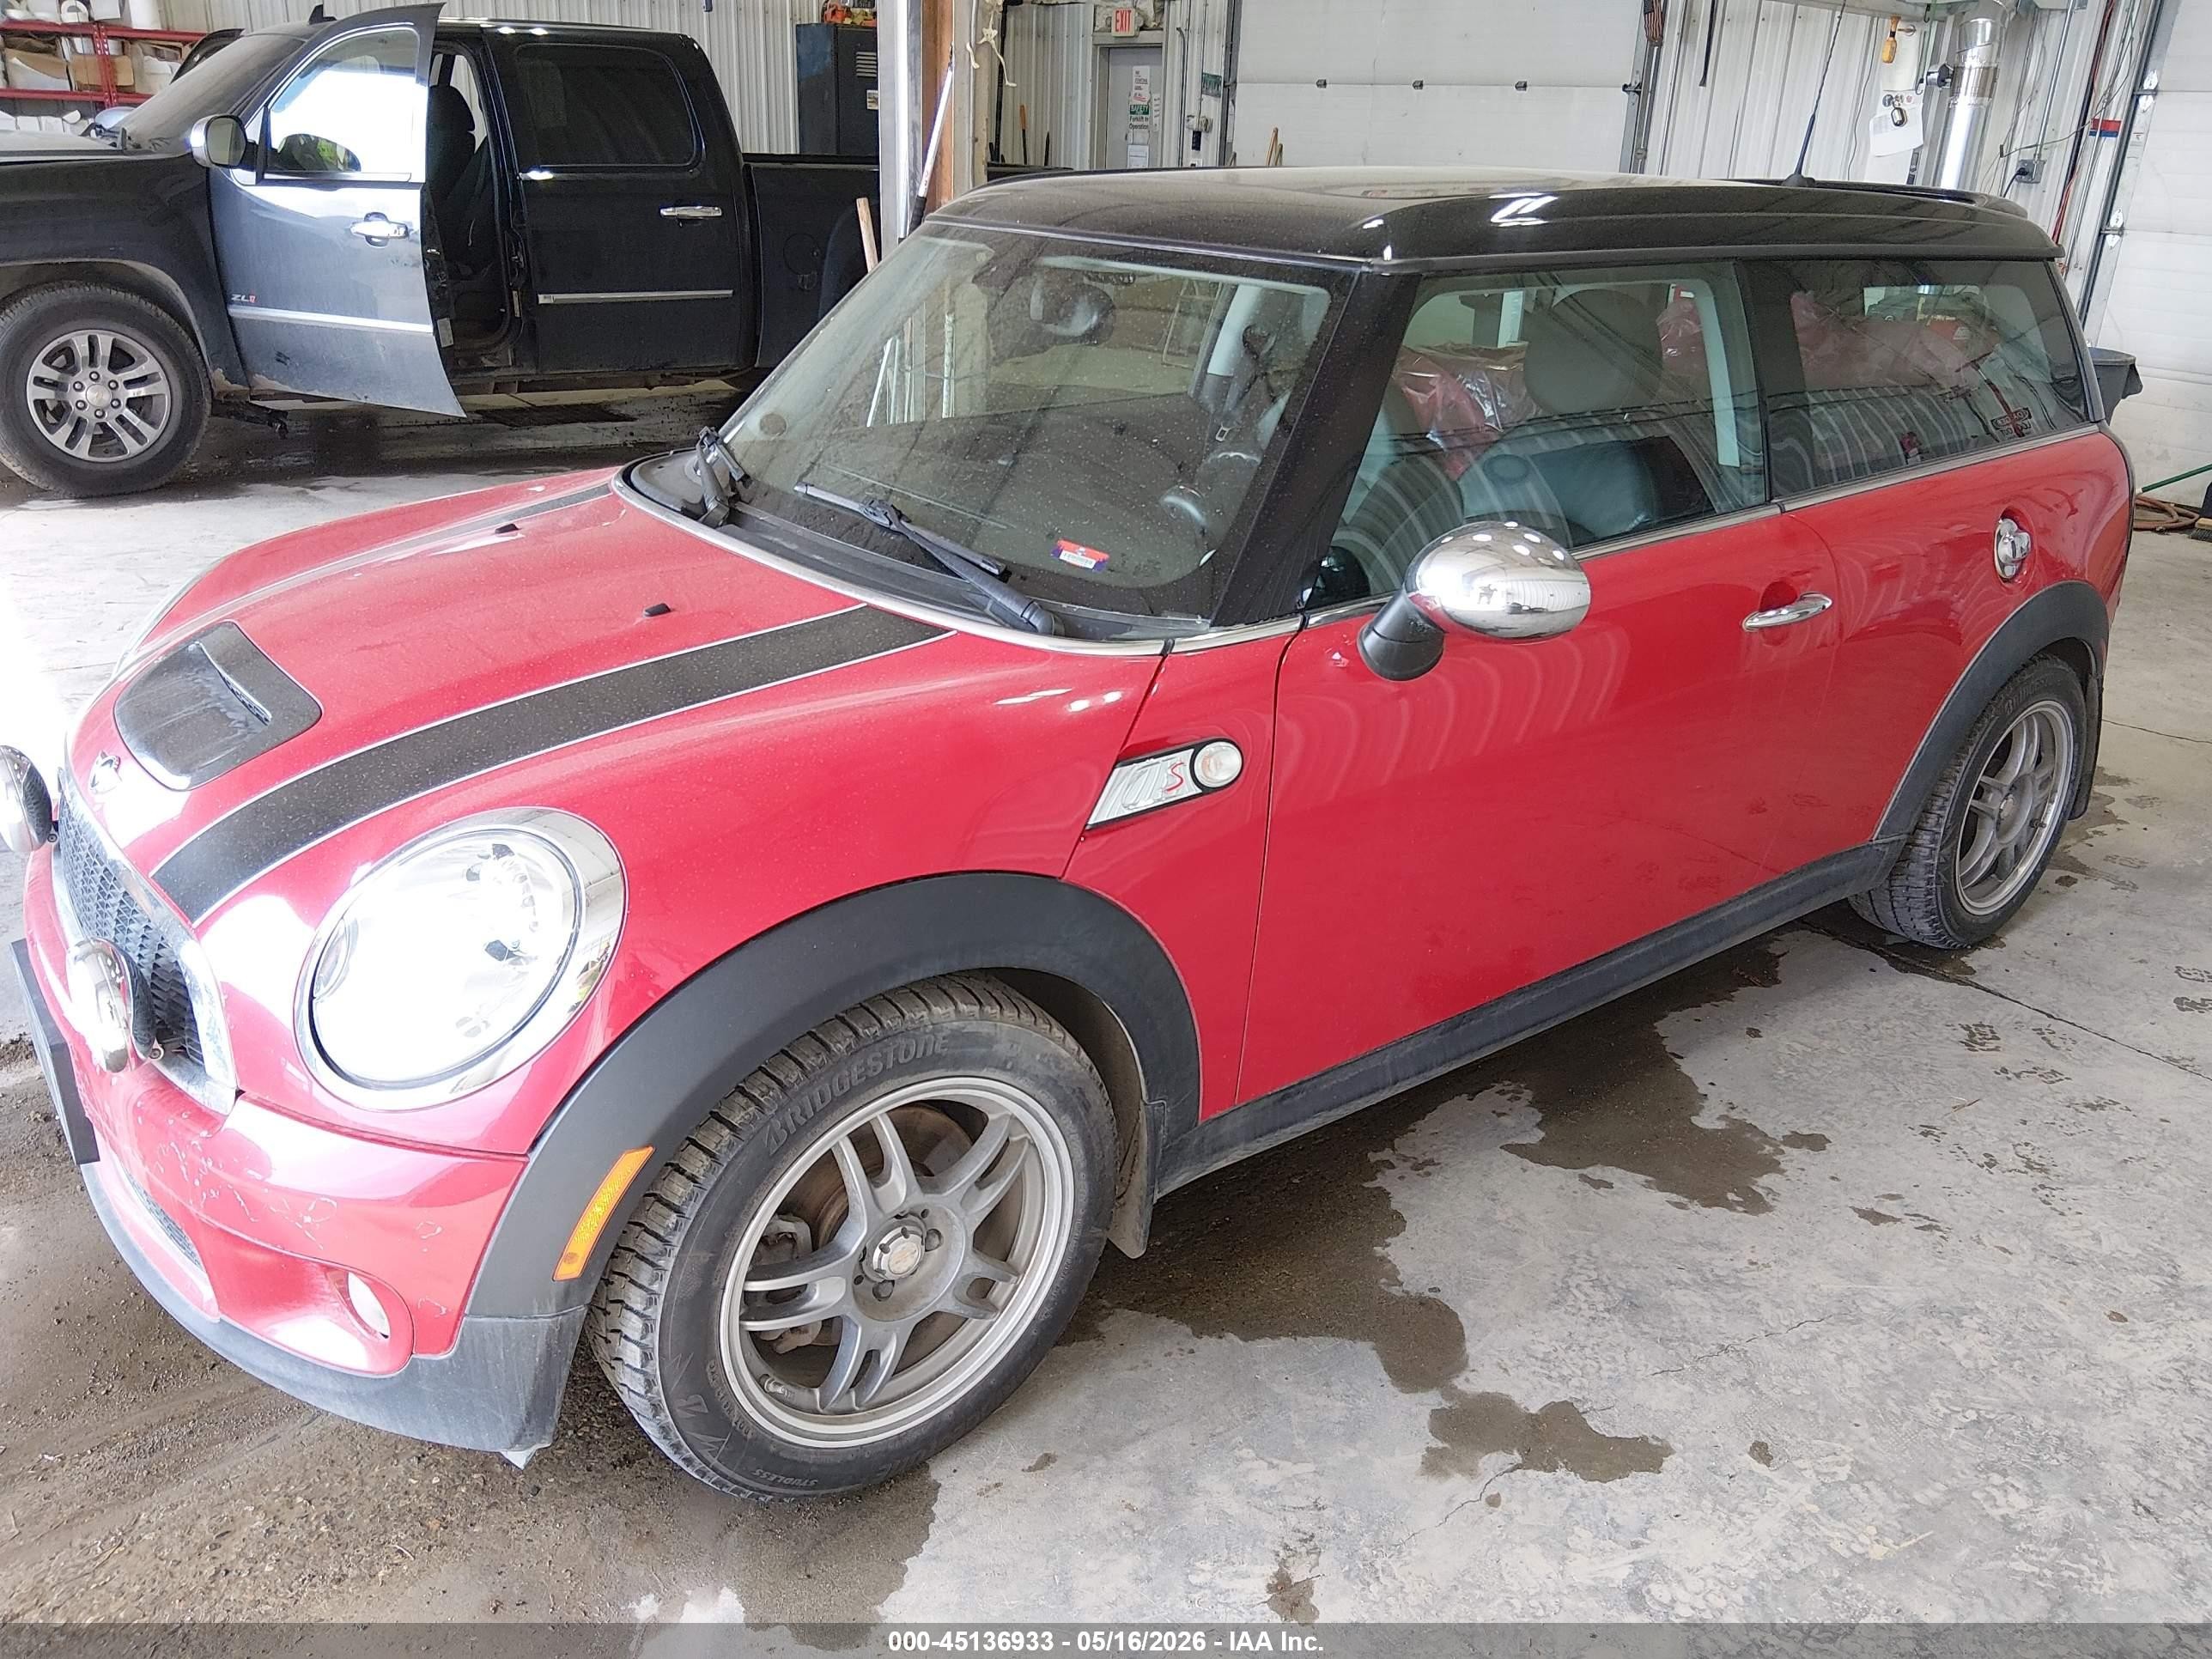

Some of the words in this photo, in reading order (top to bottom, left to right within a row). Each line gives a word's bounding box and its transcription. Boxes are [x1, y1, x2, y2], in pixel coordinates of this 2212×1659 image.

[1115, 9, 1132, 33] EXIT
[762, 1033, 950, 1157] BRIDGESTONE
[750, 1468, 819, 1486] STUDLESS
